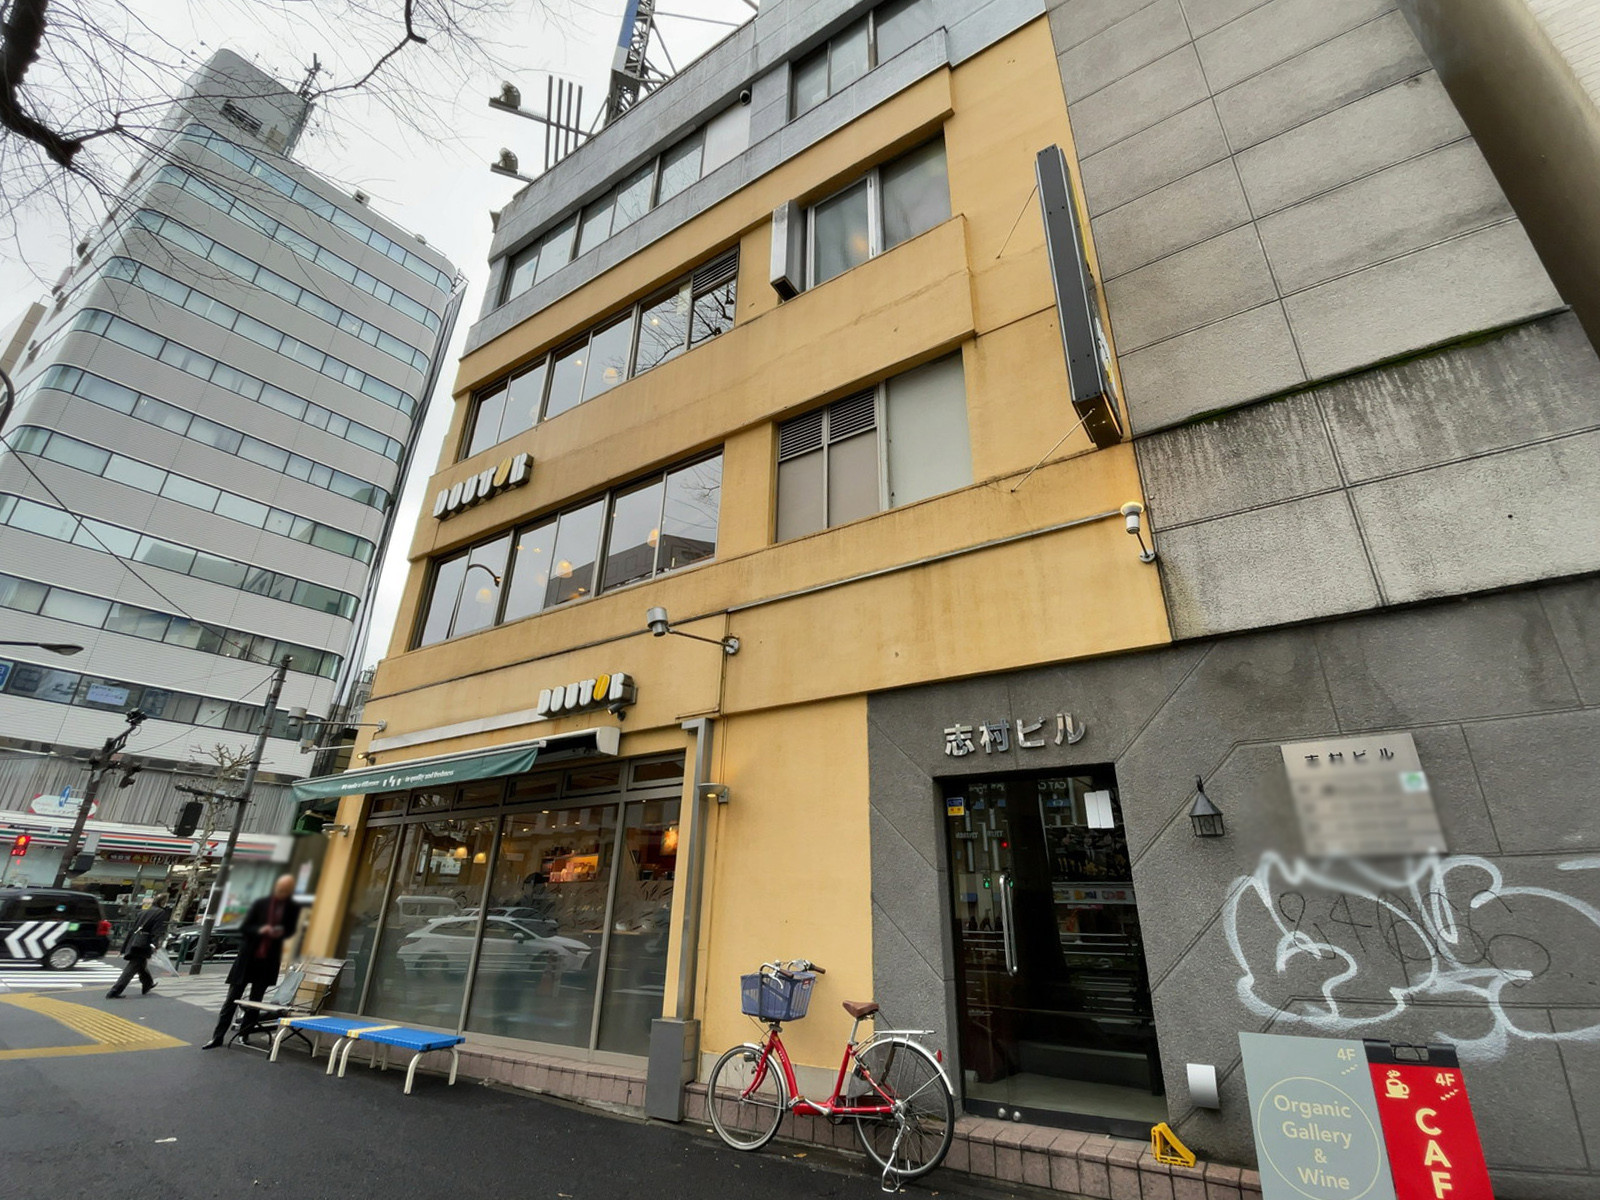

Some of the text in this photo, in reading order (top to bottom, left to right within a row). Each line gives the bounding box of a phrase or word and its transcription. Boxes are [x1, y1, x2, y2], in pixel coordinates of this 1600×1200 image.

[433, 453, 532, 519] DOUTOR
[537, 672, 630, 716] DOUTOR
[944, 712, 1087, 756] 志村ビル
[1304, 747, 1394, 761] ビル
[1337, 1048, 1356, 1061] 4F
[1435, 1073, 1455, 1087] 4F
[1273, 1094, 1352, 1119] Organic
[1282, 1121, 1352, 1149] Gallery
[1314, 1148, 1328, 1164] &
[1415, 1107, 1453, 1200] CAF
[1296, 1166, 1351, 1190] Wine
